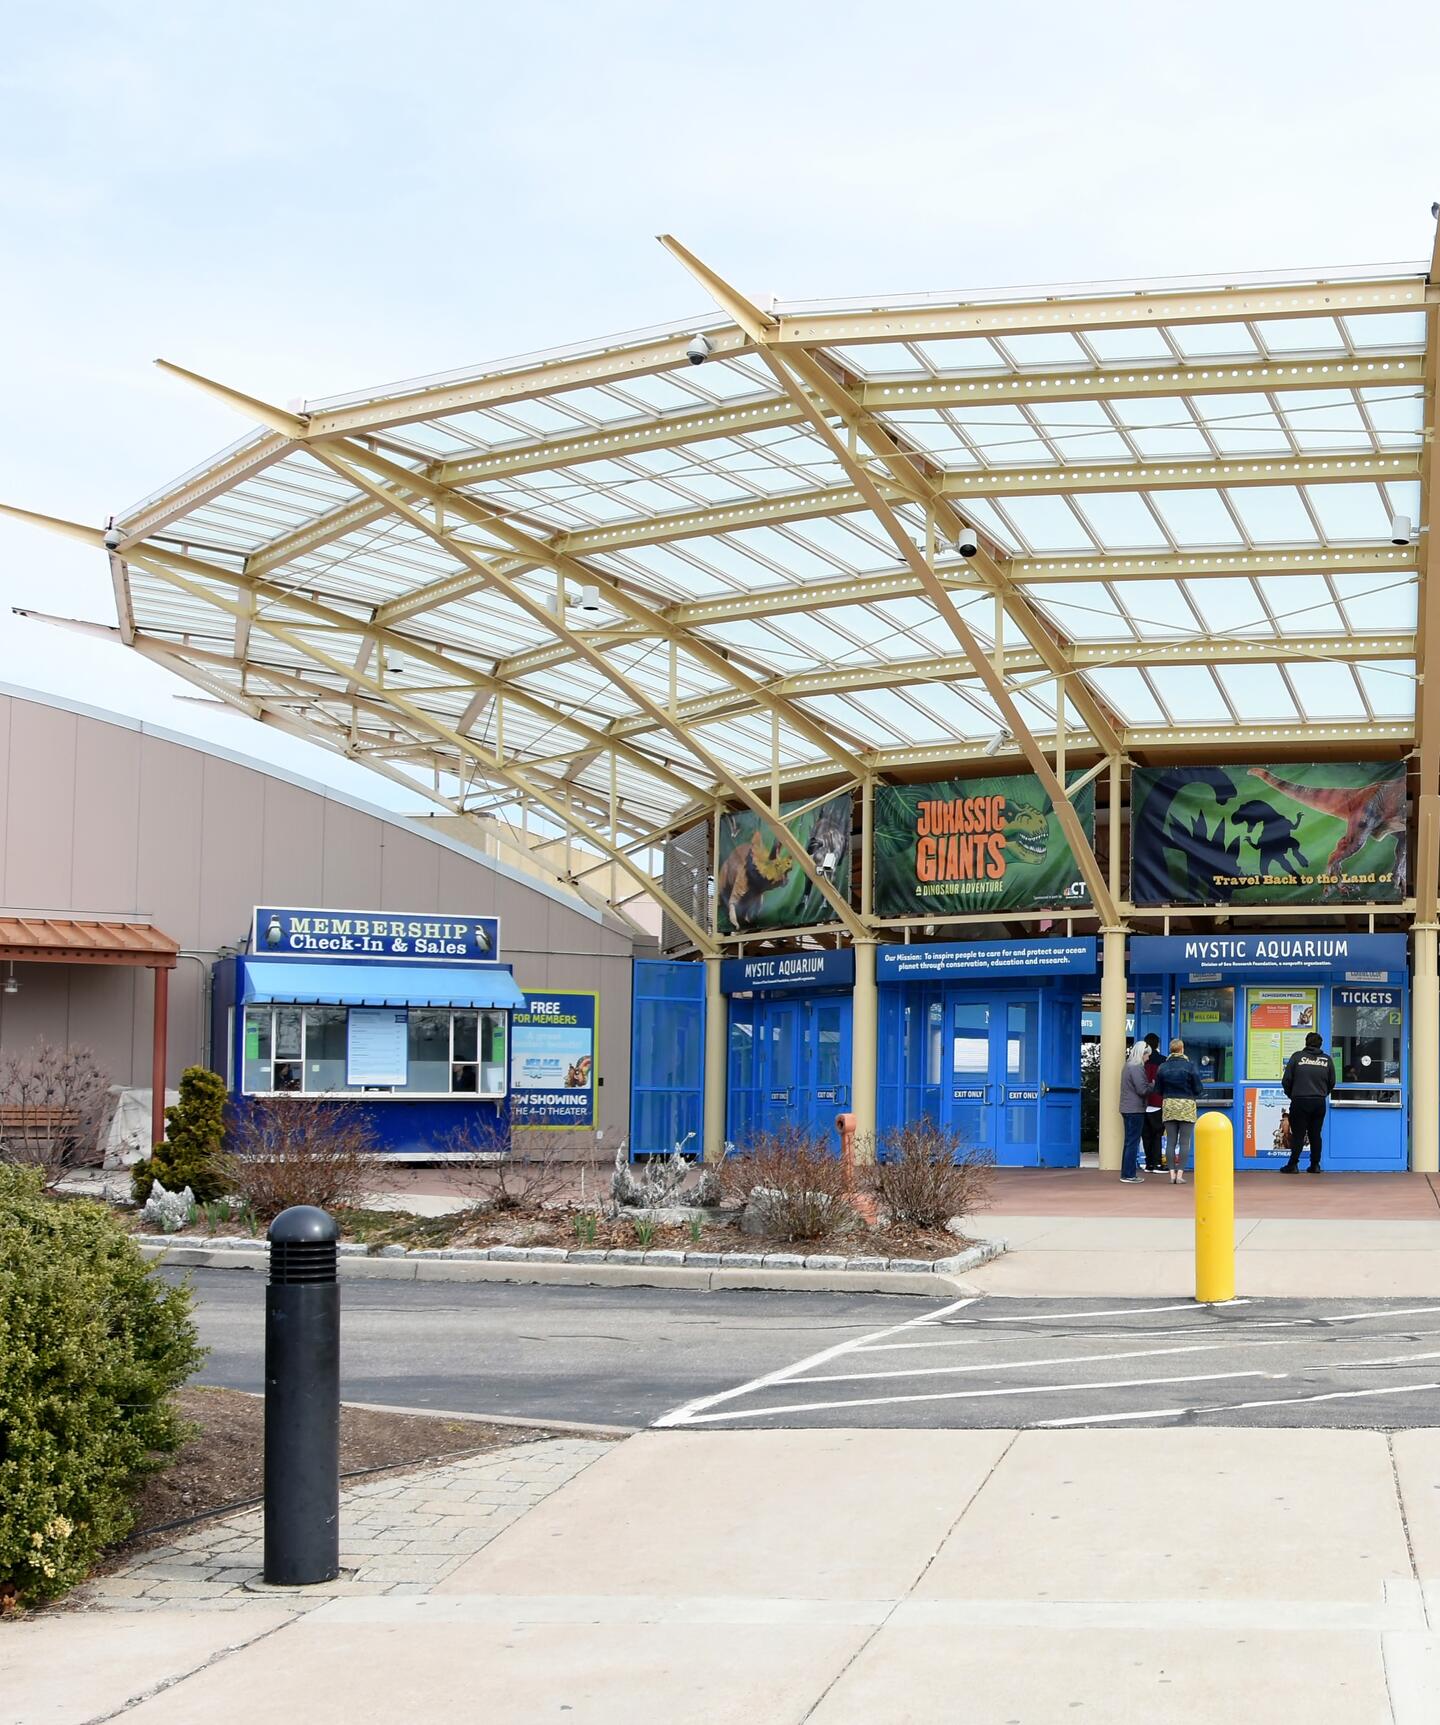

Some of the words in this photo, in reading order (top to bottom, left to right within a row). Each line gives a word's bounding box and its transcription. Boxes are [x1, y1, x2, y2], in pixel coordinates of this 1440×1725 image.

[916, 795, 1006, 836] JURASSIC
[916, 832, 1007, 882] GIANTS
[1212, 875, 1259, 885] Travel
[1263, 874, 1297, 884] Back
[1301, 875, 1313, 884] to
[1316, 874, 1337, 884] the
[1341, 874, 1375, 883] Land
[1378, 872, 1393, 883] of
[923, 883, 959, 896] DINOSAUR
[960, 880, 1003, 894] ADVENTURE
[289, 918, 468, 940] MEMBERSHIP
[290, 934, 384, 951] Check-In
[391, 938, 408, 952] &
[415, 939, 467, 954] Sales
[1185, 941, 1246, 959] MYSTIC
[1256, 940, 1348, 959] AQUARIUM
[932, 952, 954, 962] inspire
[955, 951, 977, 961] people
[1013, 948, 1026, 956] and
[1027, 948, 1051, 958] protect
[745, 962, 775, 978] MYSTIC
[779, 957, 824, 975] AQUARIUM
[898, 962, 919, 972] planet
[920, 961, 945, 971] through
[946, 960, 990, 968] conservation,
[991, 958, 1024, 966] education
[1025, 957, 1038, 965] and
[1039, 956, 1071, 964] research.
[1341, 992, 1392, 1004] TICKETS
[530, 1002, 560, 1014] FREE
[513, 1014, 531, 1024] FOR
[532, 1014, 577, 1024] MEMBERS
[1391, 1014, 1399, 1023] 2
[1298, 1056, 1328, 1067] Steelers
[529, 1094, 587, 1105] SHOWING
[548, 1107, 587, 1115] THEATER
